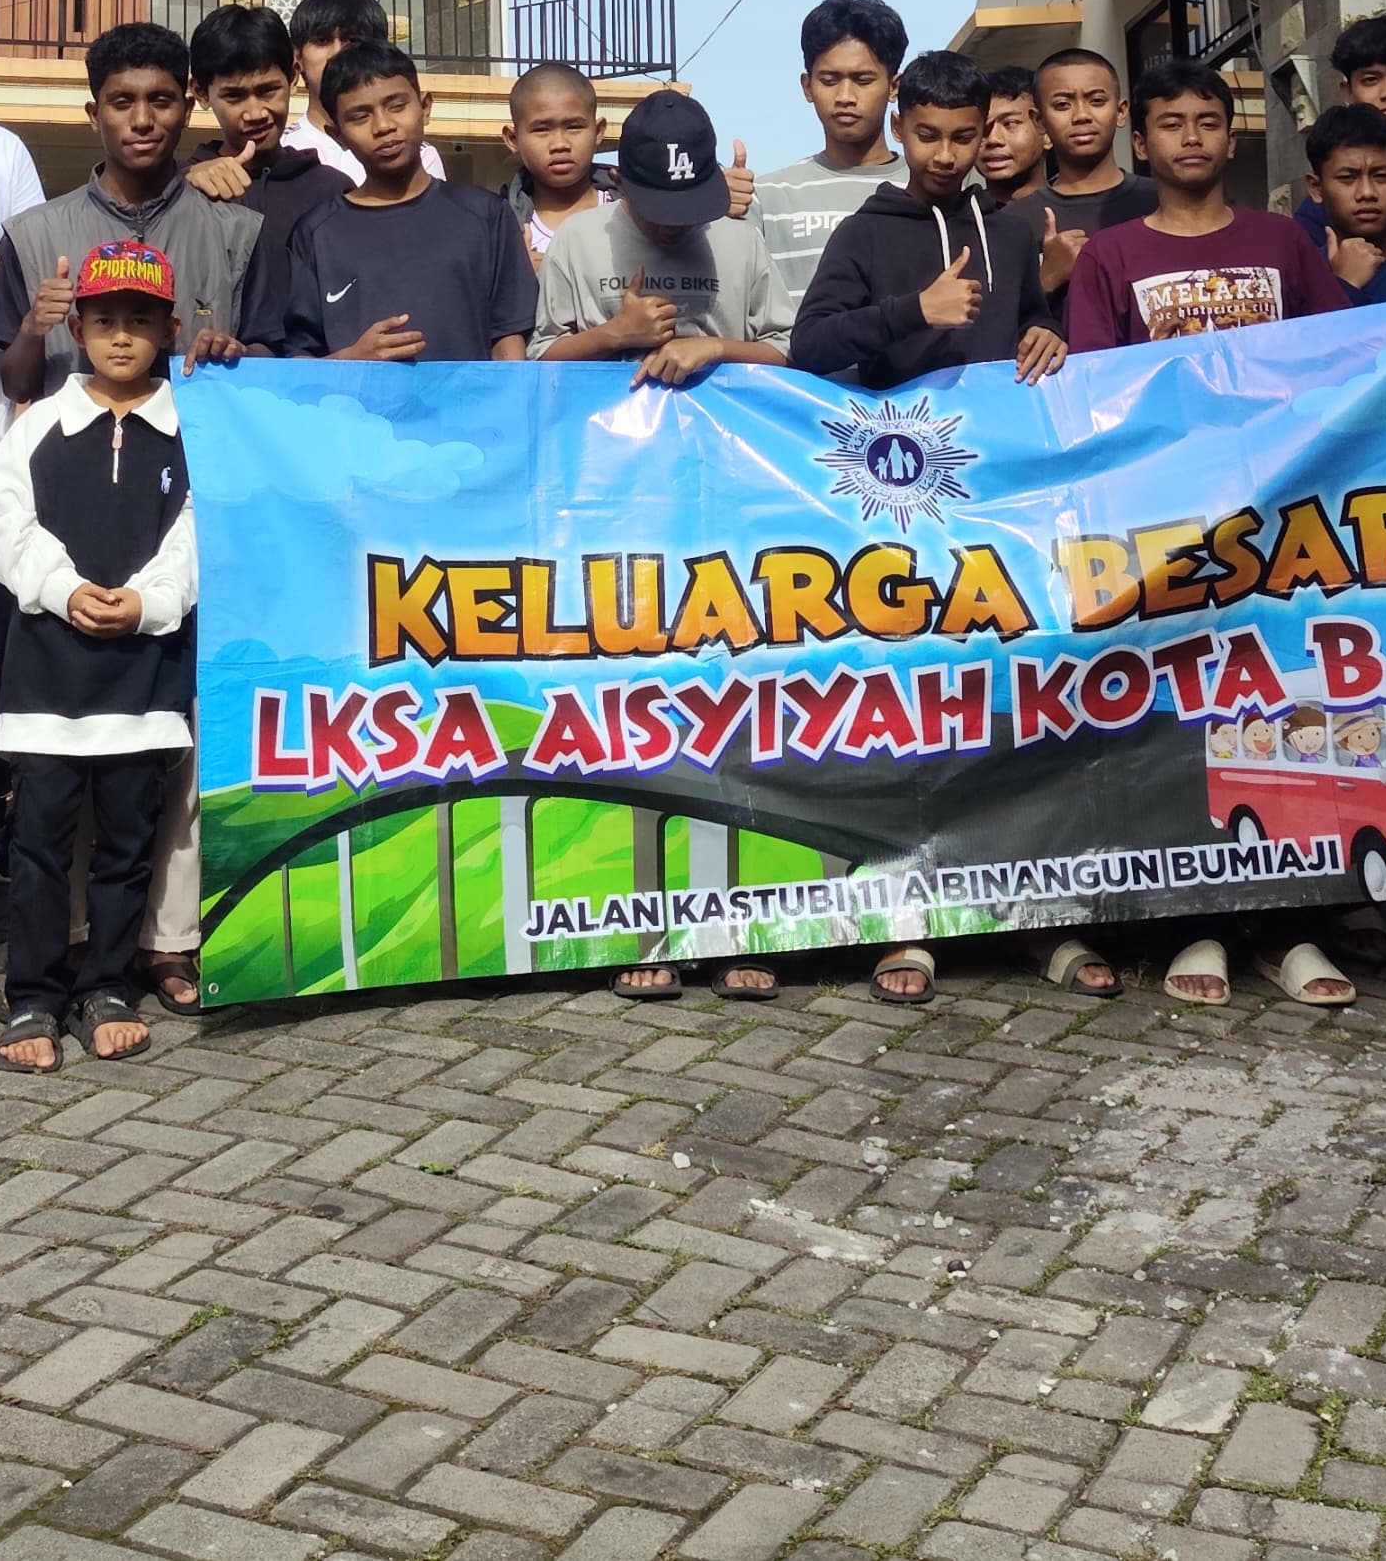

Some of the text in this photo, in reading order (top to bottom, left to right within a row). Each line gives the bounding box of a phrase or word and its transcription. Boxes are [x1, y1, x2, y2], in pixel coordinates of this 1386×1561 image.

[666, 143, 695, 180] LA
[89, 259, 162, 286] SPIDER-MAN
[599, 276, 720, 292] FOLING BIKE
[1150, 278, 1274, 310] MELAKA
[366, 542, 1037, 668] KELUARGA
[252, 684, 508, 794] LKSA
[524, 661, 993, 775] AISYIYAH
[1012, 625, 1296, 749] KOTA
[524, 839, 1341, 937] JALAN KASTUBI 11 A BINANGUN BUMIAJI
